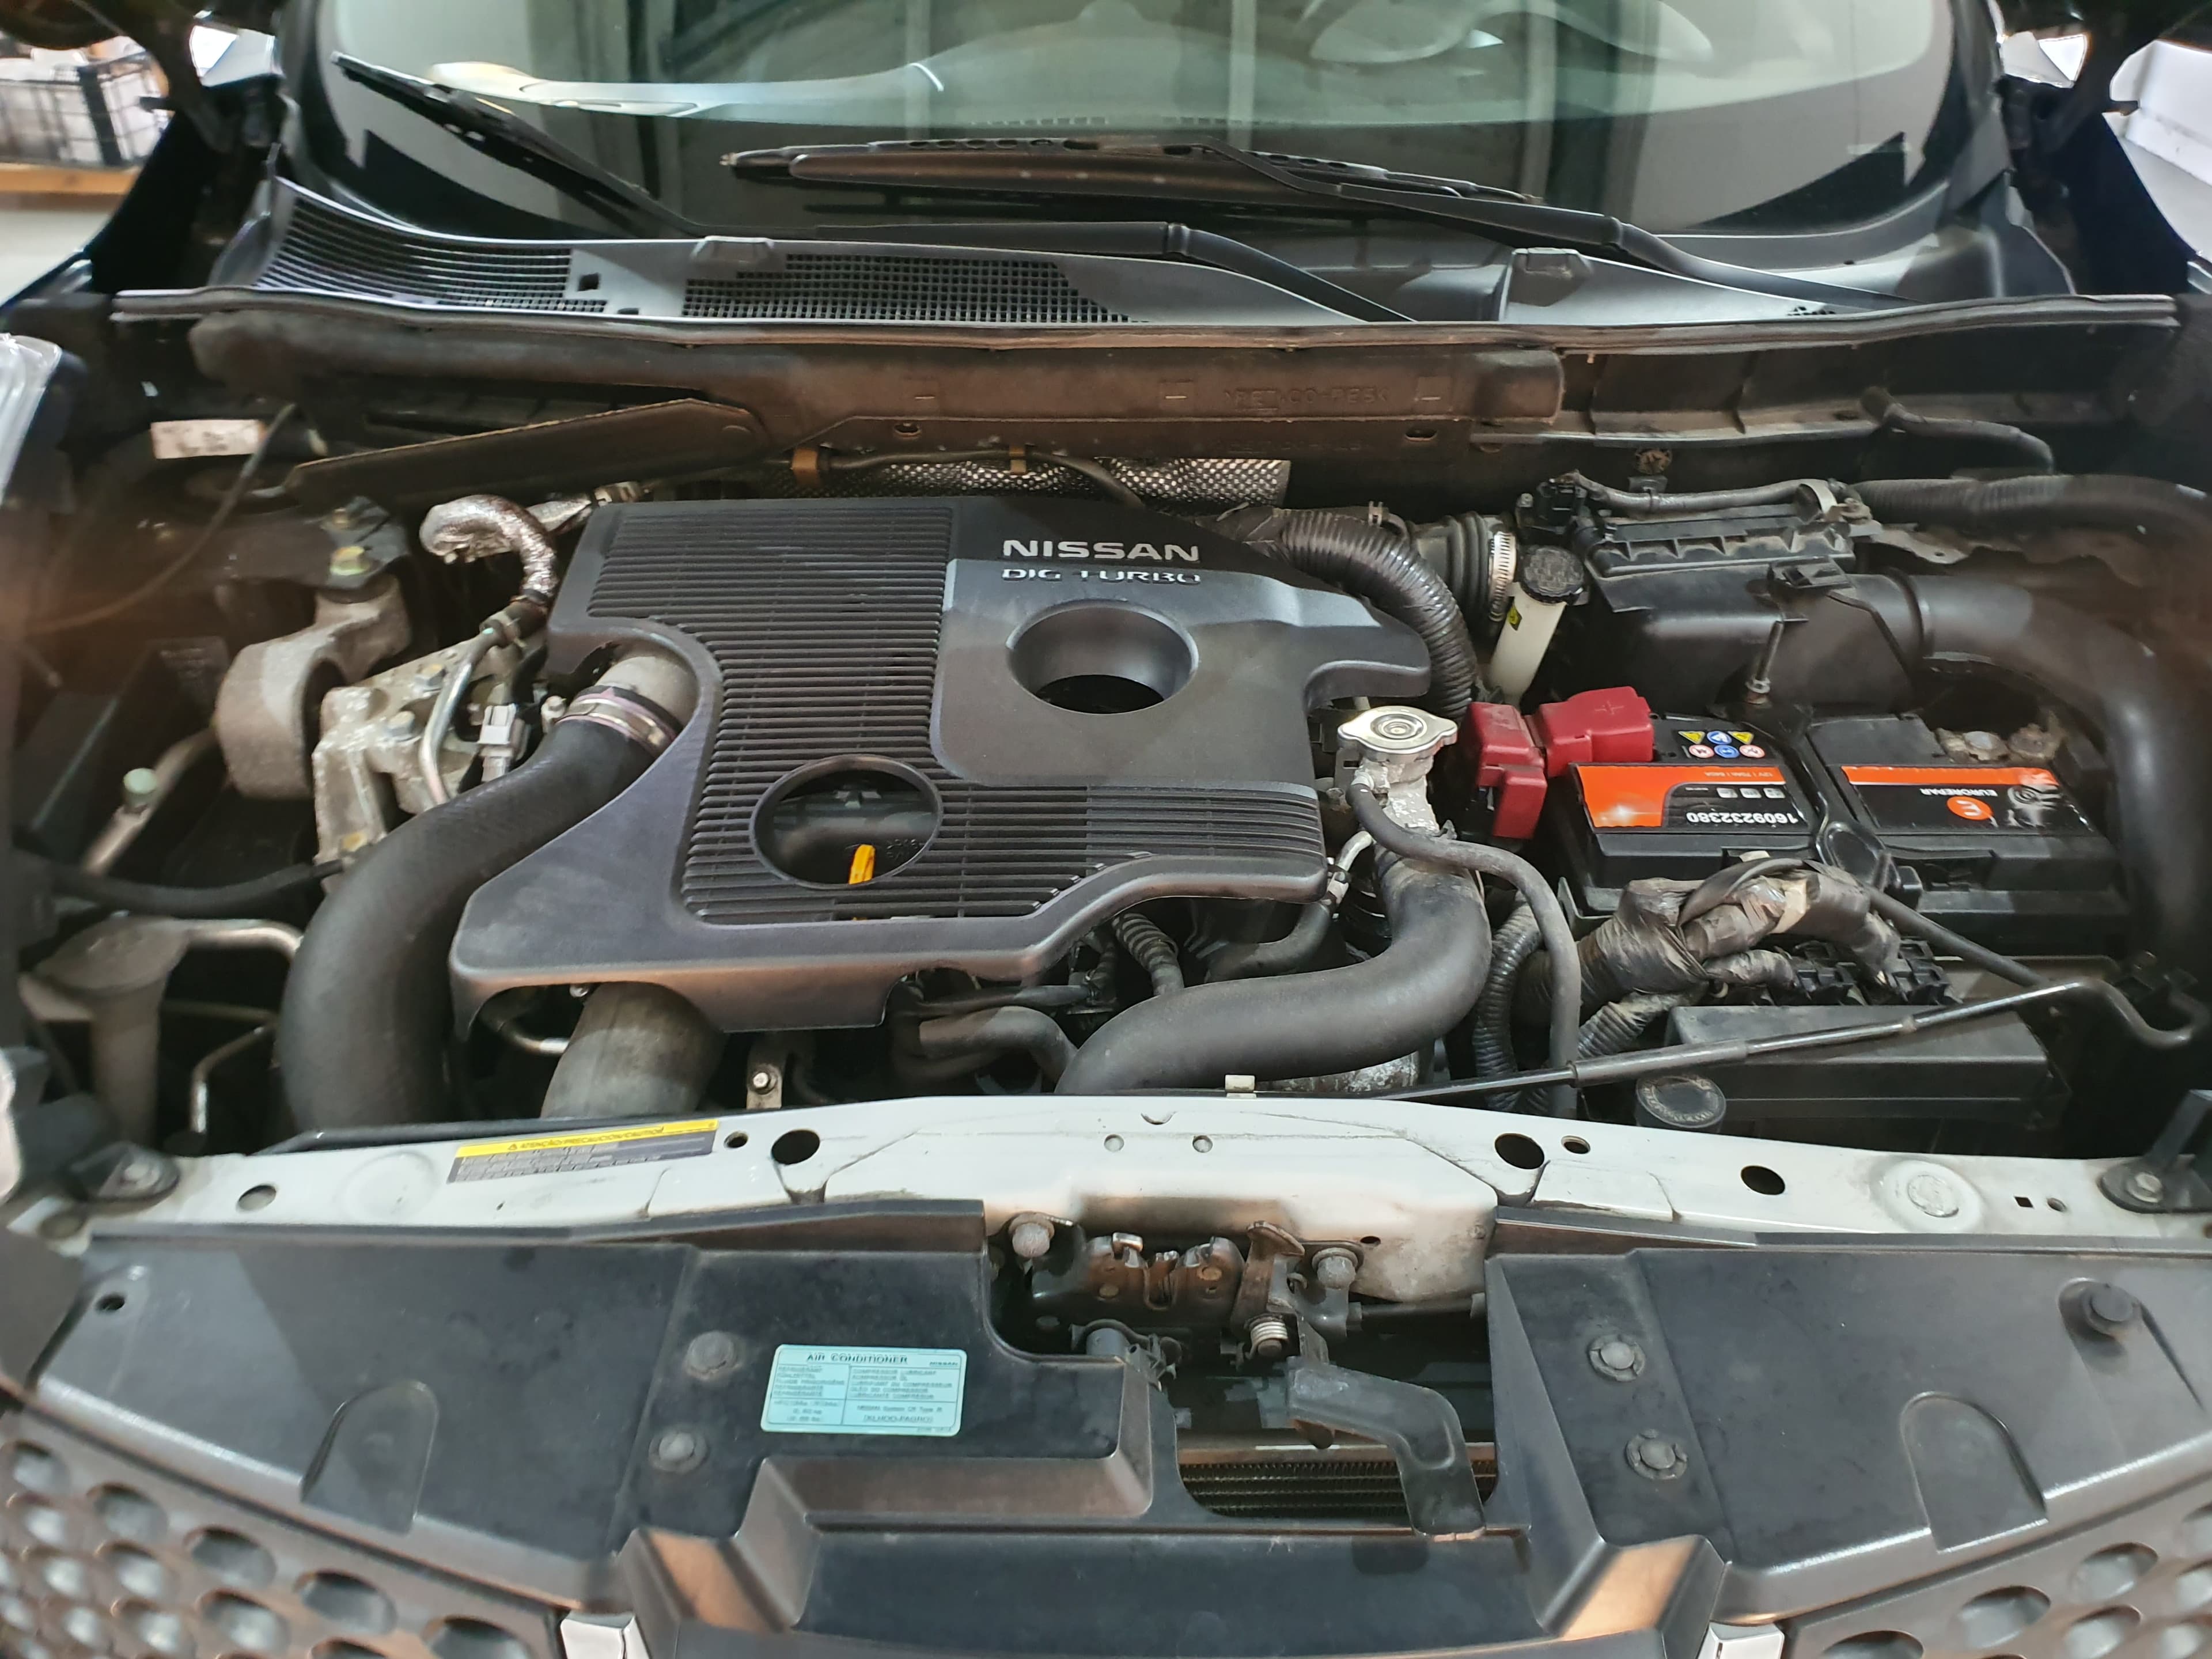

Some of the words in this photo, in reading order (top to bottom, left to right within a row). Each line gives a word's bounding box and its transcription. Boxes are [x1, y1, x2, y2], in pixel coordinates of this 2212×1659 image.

[1003, 540, 1200, 562] NISSAN
[1002, 569, 1062, 582] DIG
[1080, 570, 1202, 585] TURBO
[1919, 788, 1998, 797] EUROREPAR
[1686, 812, 1799, 824] 1609232380
[806, 1354, 825, 1362] AIR
[831, 1354, 908, 1364] CONDITIONER
